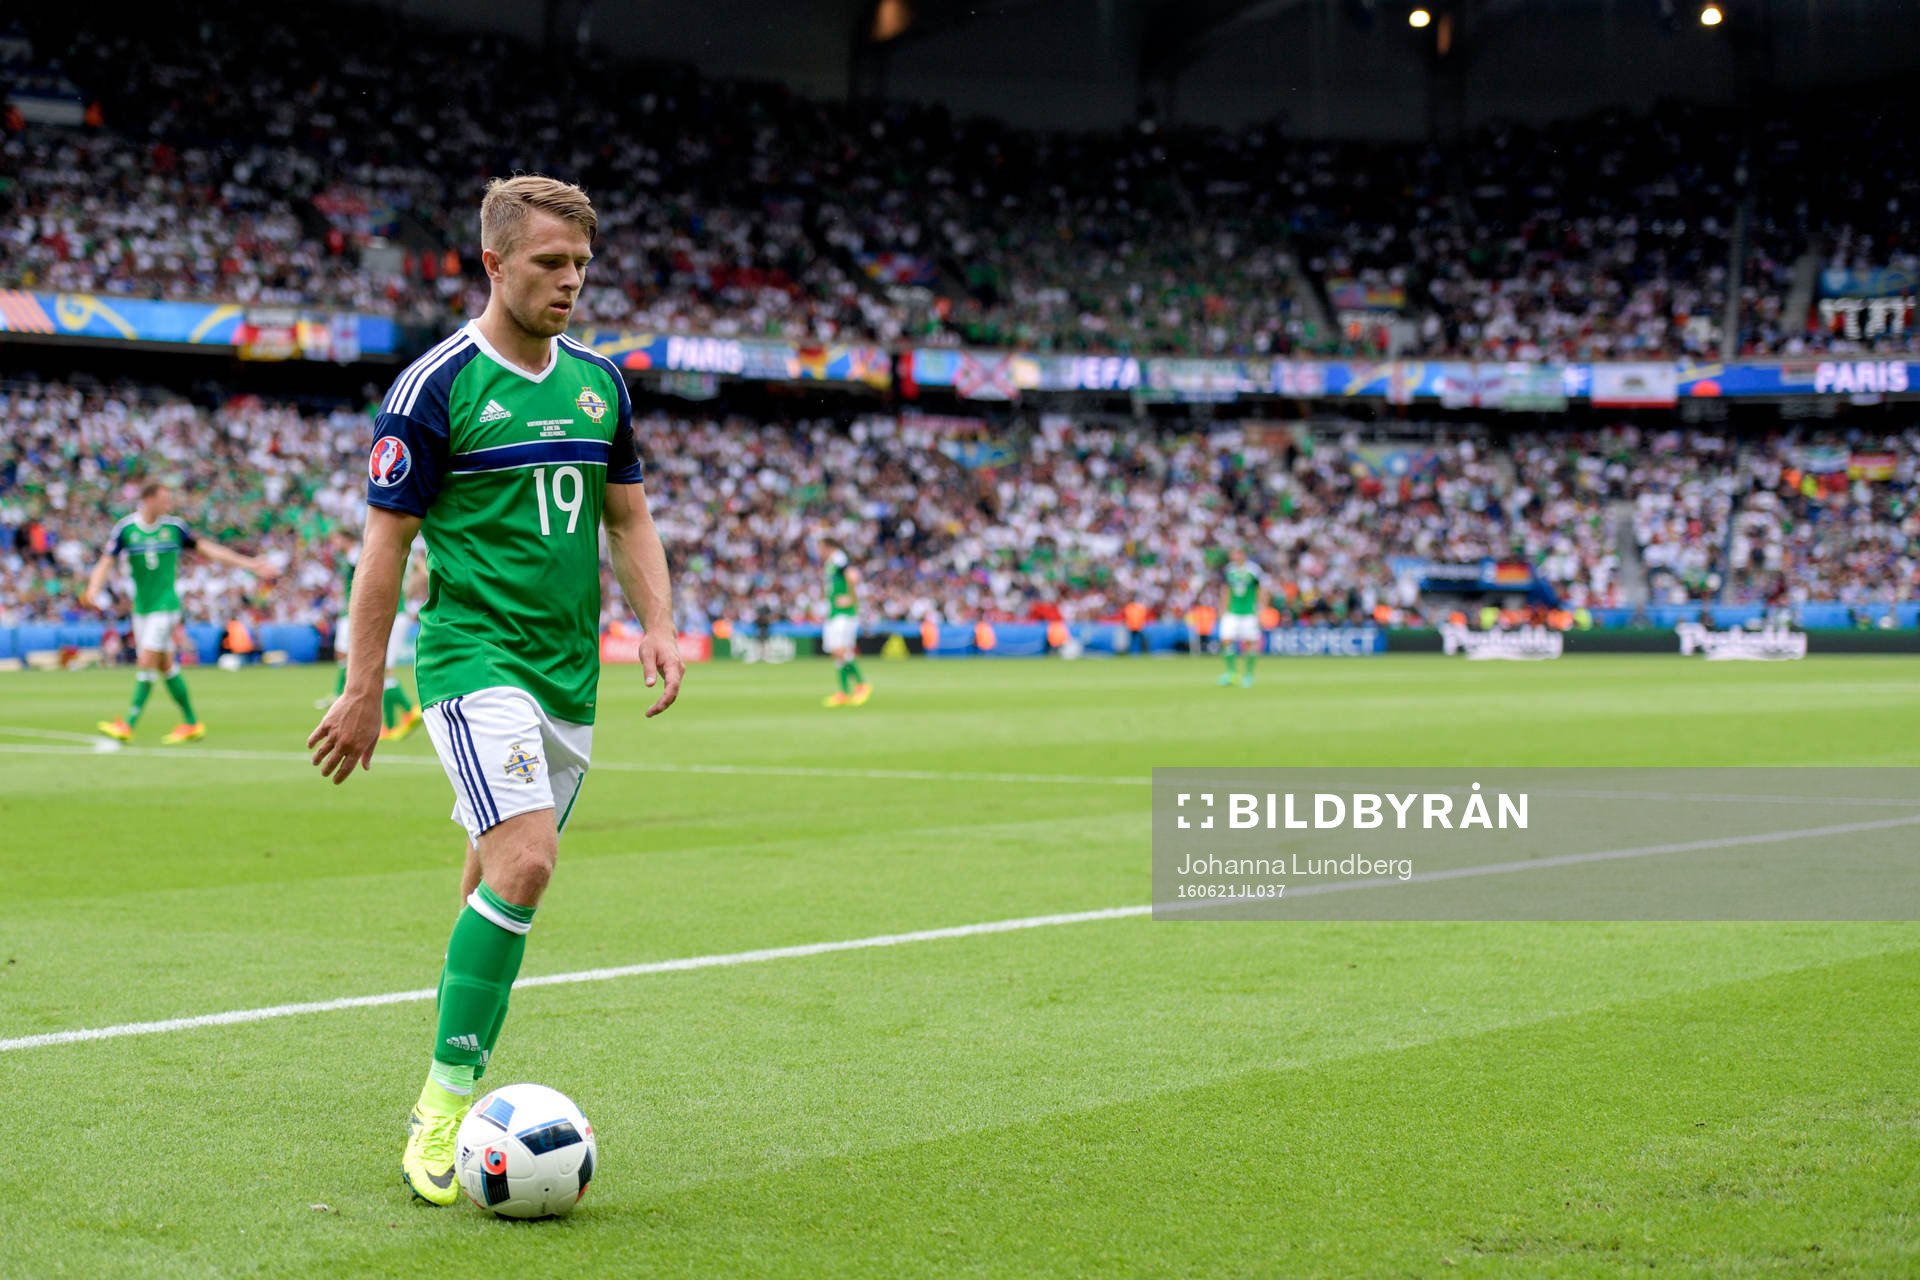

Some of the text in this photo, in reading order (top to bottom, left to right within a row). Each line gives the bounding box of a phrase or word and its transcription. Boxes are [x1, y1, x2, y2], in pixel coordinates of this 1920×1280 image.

[667, 336, 743, 373] PARIS
[1814, 361, 1908, 393] PARIS
[479, 410, 512, 423] adidas
[532, 466, 584, 536] 19
[1269, 627, 1377, 655] RESPECT
